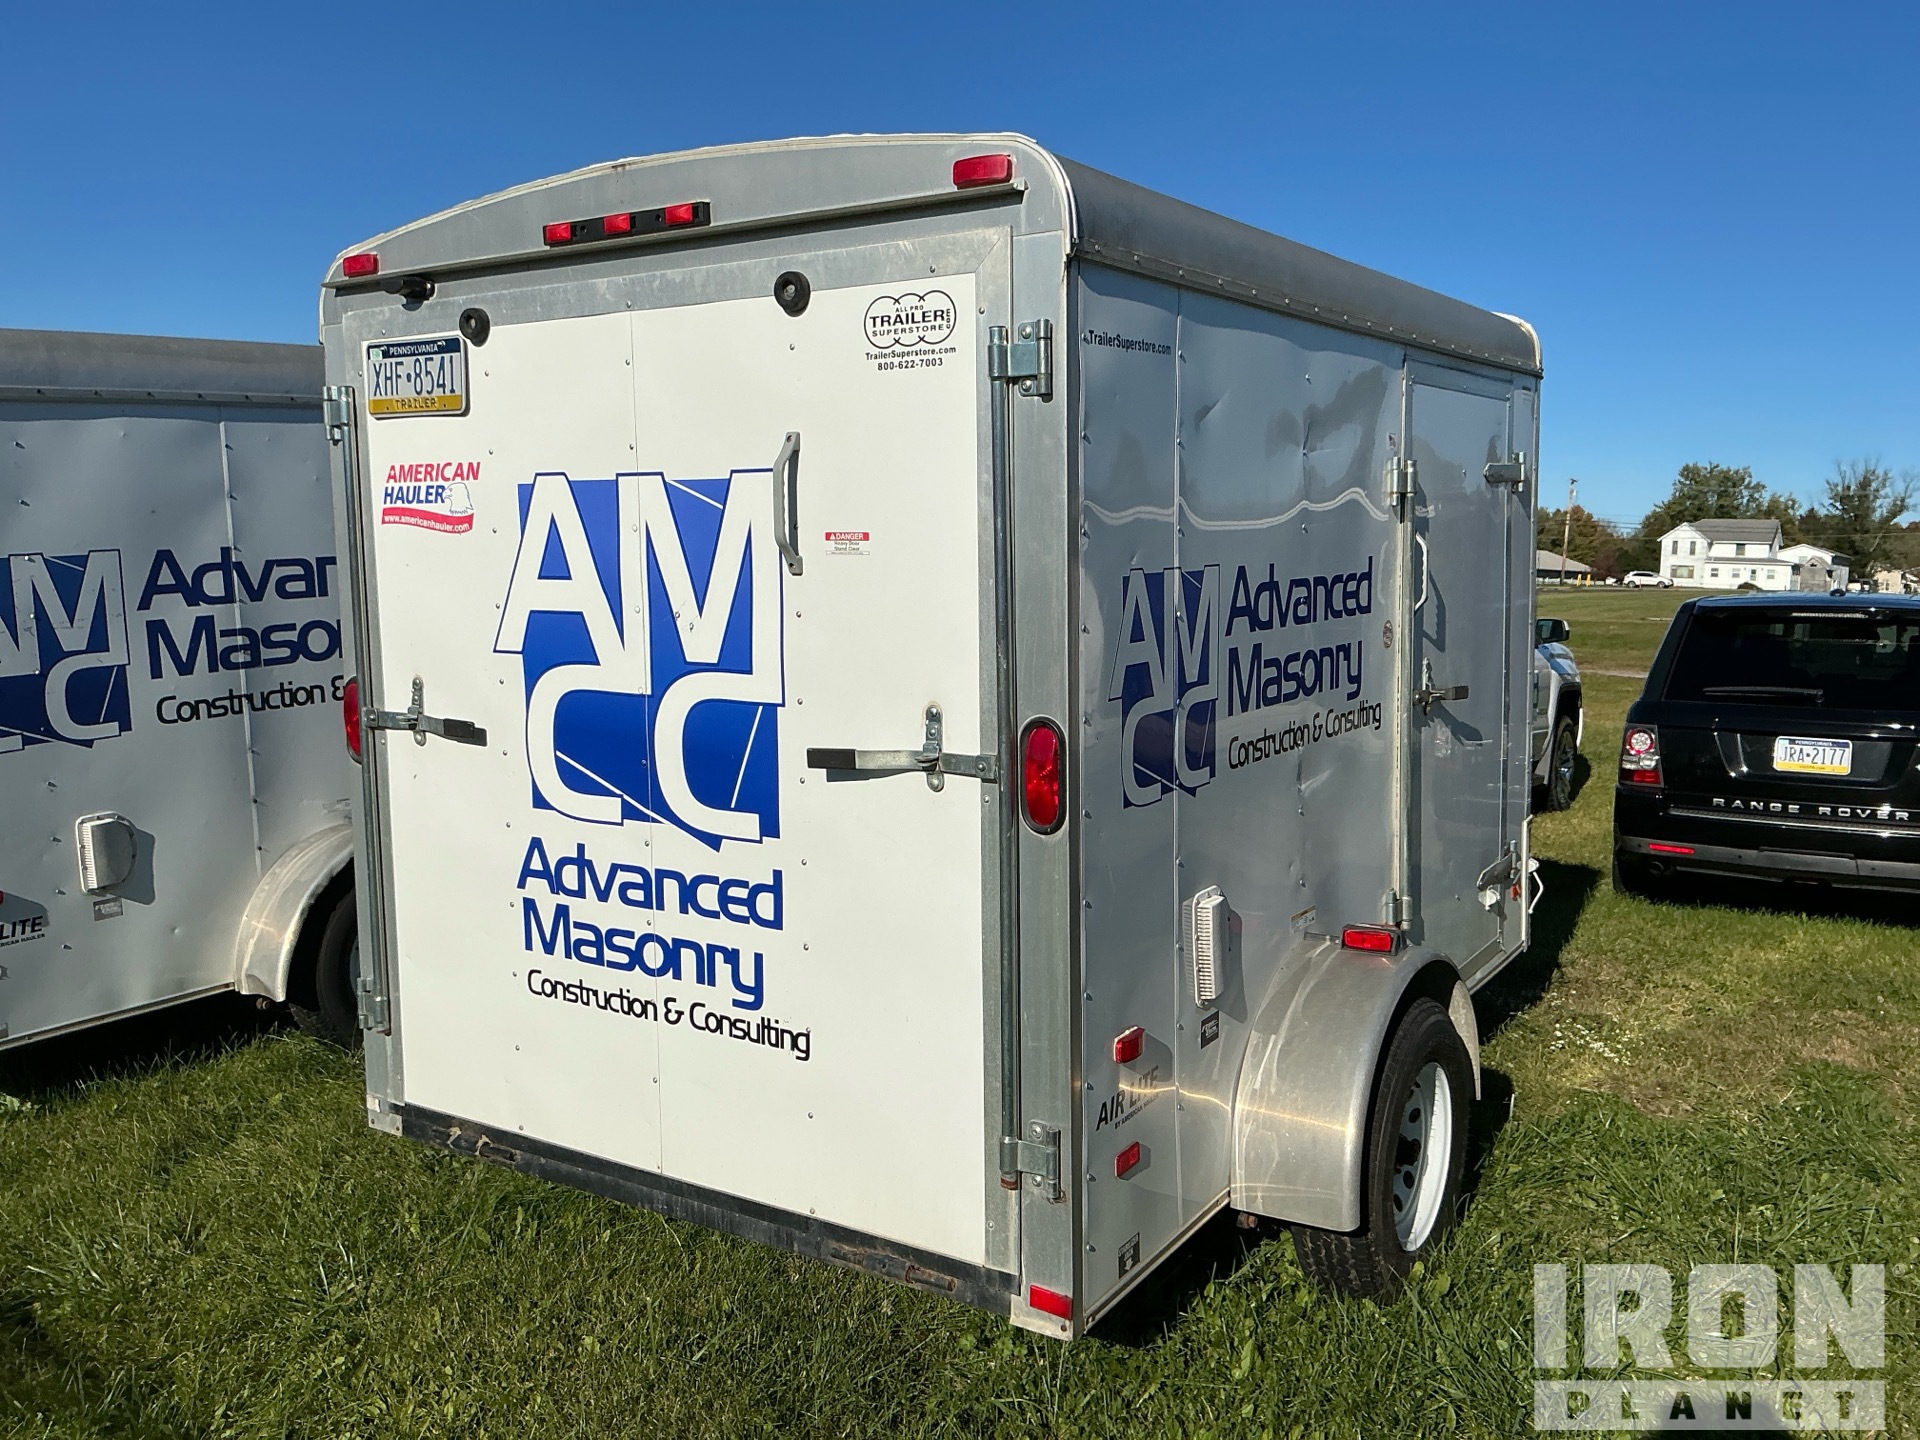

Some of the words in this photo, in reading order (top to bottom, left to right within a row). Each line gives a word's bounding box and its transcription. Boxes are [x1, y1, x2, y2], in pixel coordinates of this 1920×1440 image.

[869, 309, 945, 328] TRAILER
[910, 304, 924, 312] PRO
[872, 323, 944, 337] SUPERSTORE
[389, 343, 439, 356] PENNSYLVANIA
[865, 346, 956, 360] TrailerSuperstore.com
[1088, 329, 1172, 355] TrailerSuperstore.com
[877, 357, 943, 371] 800-622-7003
[395, 397, 437, 411] TRAILER
[386, 461, 481, 483] AMERICAN
[383, 485, 446, 505] HAULER
[384, 515, 470, 532] www.americanhauler.com
[835, 532, 864, 540] DANGER
[1225, 555, 1373, 637] Advanced
[145, 615, 343, 680] Maso
[1227, 640, 1363, 717] Masonry
[156, 680, 326, 725] Construction
[1228, 722, 1310, 770] Construction
[1312, 712, 1323, 743] &
[1325, 700, 1382, 738] Consulting
[1712, 797, 1800, 813] RANGE
[1819, 806, 1910, 821] ROVER
[517, 836, 784, 931] Advanced
[0, 915, 43, 940] LITE
[21, 933, 46, 943] HAULER
[522, 896, 764, 1011] Masonry
[527, 969, 658, 1021] Construction
[663, 997, 684, 1025] &
[689, 1002, 811, 1062] Consulting
[1095, 1089, 1126, 1132] AIR
[1129, 1065, 1159, 1109] LITE
